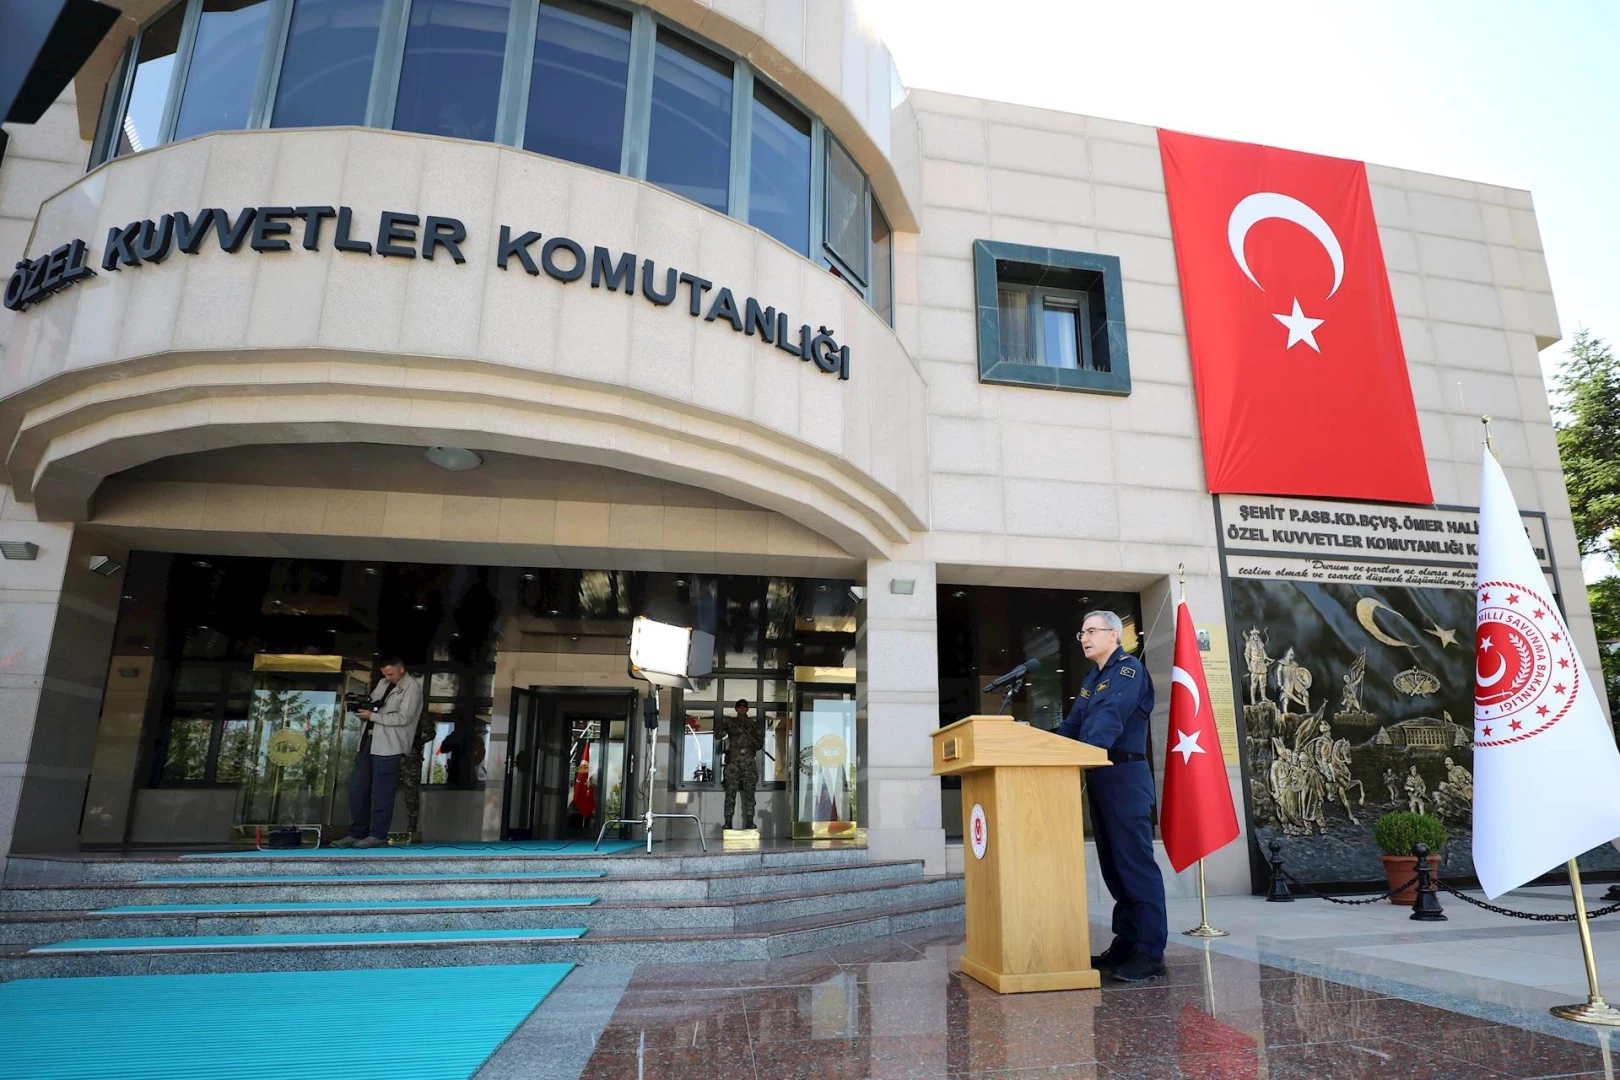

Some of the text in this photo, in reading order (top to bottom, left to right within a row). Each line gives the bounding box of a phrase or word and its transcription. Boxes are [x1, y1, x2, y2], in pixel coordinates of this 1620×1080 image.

[4, 206, 850, 380] ÖZEL KUVVETLER KOMUTANLIĞI
[1239, 504, 1285, 521] ŞEHİT
[1227, 524, 1269, 542] ÖZEL
[1272, 529, 1363, 548] KUVVETLER
[1365, 536, 1464, 555] KOMUTANLIĞI
[1238, 566, 1271, 576] teslim
[1275, 567, 1308, 577] olmak
[1312, 571, 1323, 579] ve
[1478, 611, 1546, 712] MİLLİ SAVUNMA BAKANLIĞI
